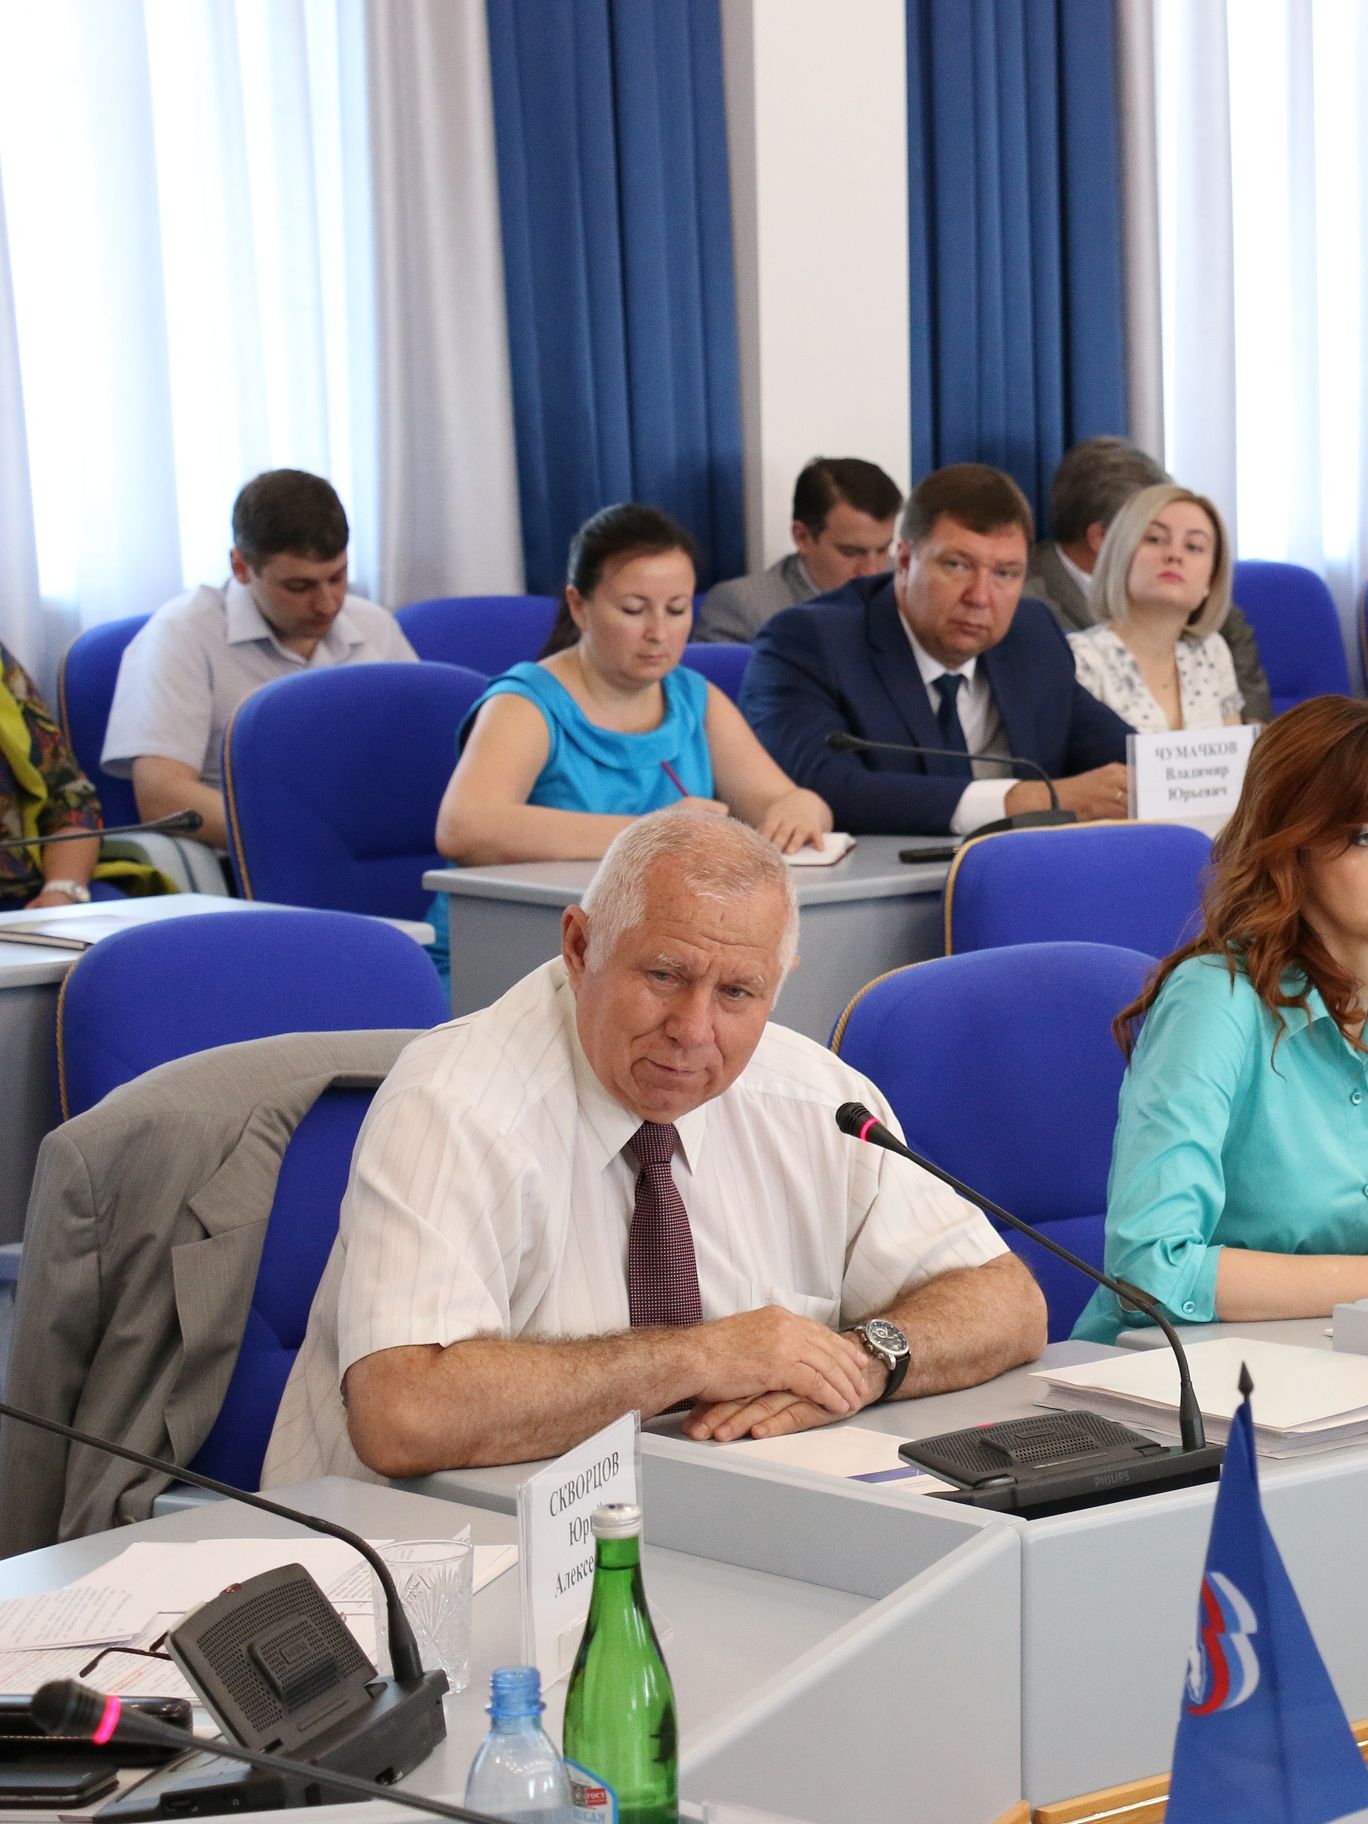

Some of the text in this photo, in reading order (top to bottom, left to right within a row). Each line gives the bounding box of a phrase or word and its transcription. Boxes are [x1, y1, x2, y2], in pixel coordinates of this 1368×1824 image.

[1155, 741, 1238, 761] ЧУМАЧКОВ
[1166, 765, 1229, 780] Владимир
[1168, 786, 1228, 802] Юрьевич
[550, 1451, 620, 1517] СКВОРЦОВ
[1095, 1470, 1130, 1488] PHILIPS
[569, 1515, 593, 1546] Юр
[555, 1555, 594, 1599] Алексе
